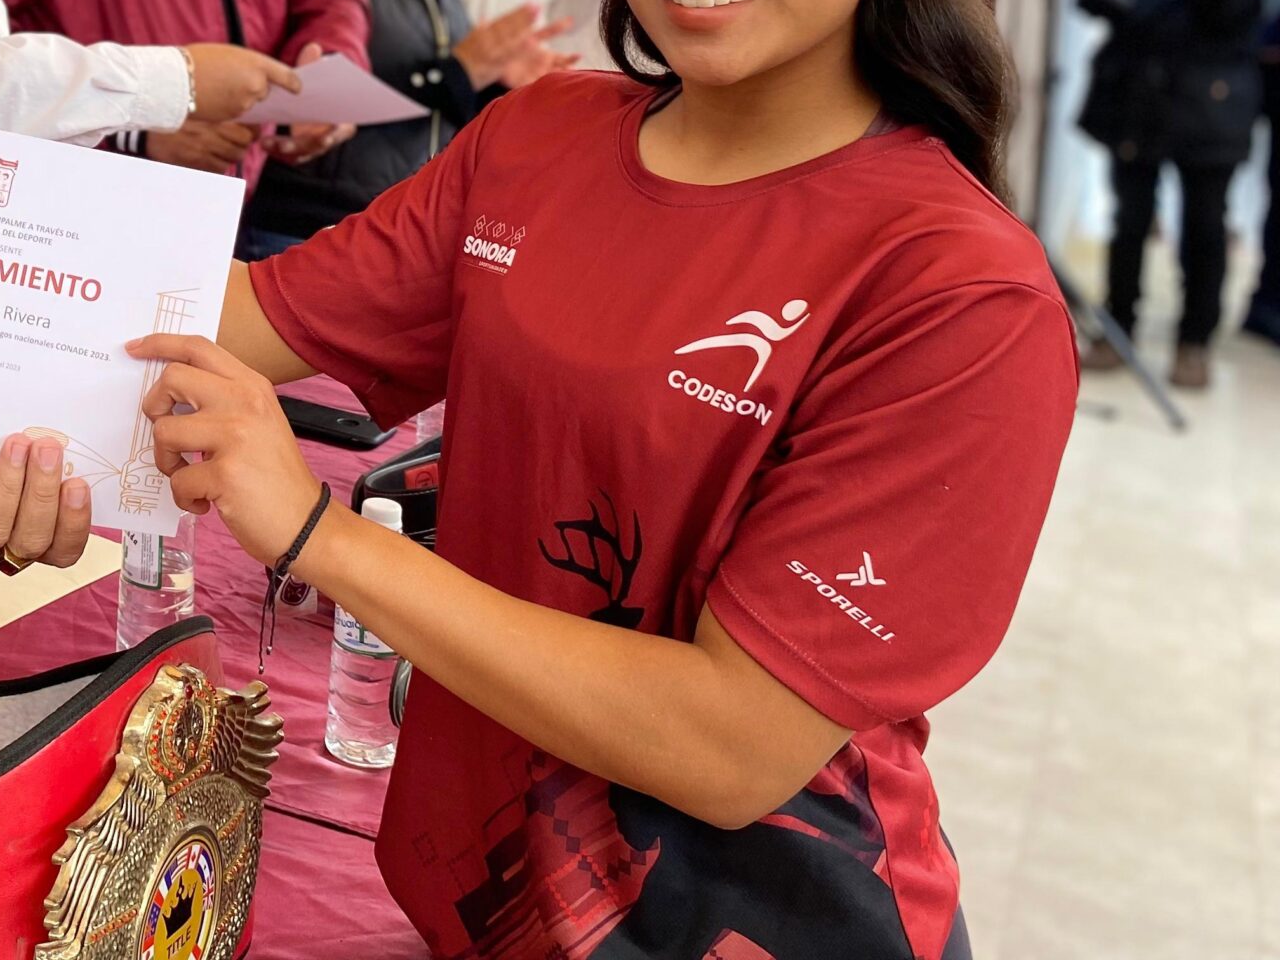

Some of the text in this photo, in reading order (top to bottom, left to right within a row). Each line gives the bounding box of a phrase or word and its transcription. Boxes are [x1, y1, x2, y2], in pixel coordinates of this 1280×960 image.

[2, 228, 16, 239] DEL
[17, 231, 53, 246] DEPORTE
[27, 222, 34, 231] A
[35, 224, 64, 238] TRAVÉS
[65, 231, 80, 240] DEL
[464, 235, 516, 267] SONORA
[3, 305, 51, 329] Rivera
[14, 334, 54, 349] nacionales
[55, 342, 88, 357] CONADE
[90, 350, 111, 362] 2023.
[668, 370, 772, 426] CODESON
[786, 560, 894, 641] SPORELLI
[167, 925, 192, 960] TITLE
